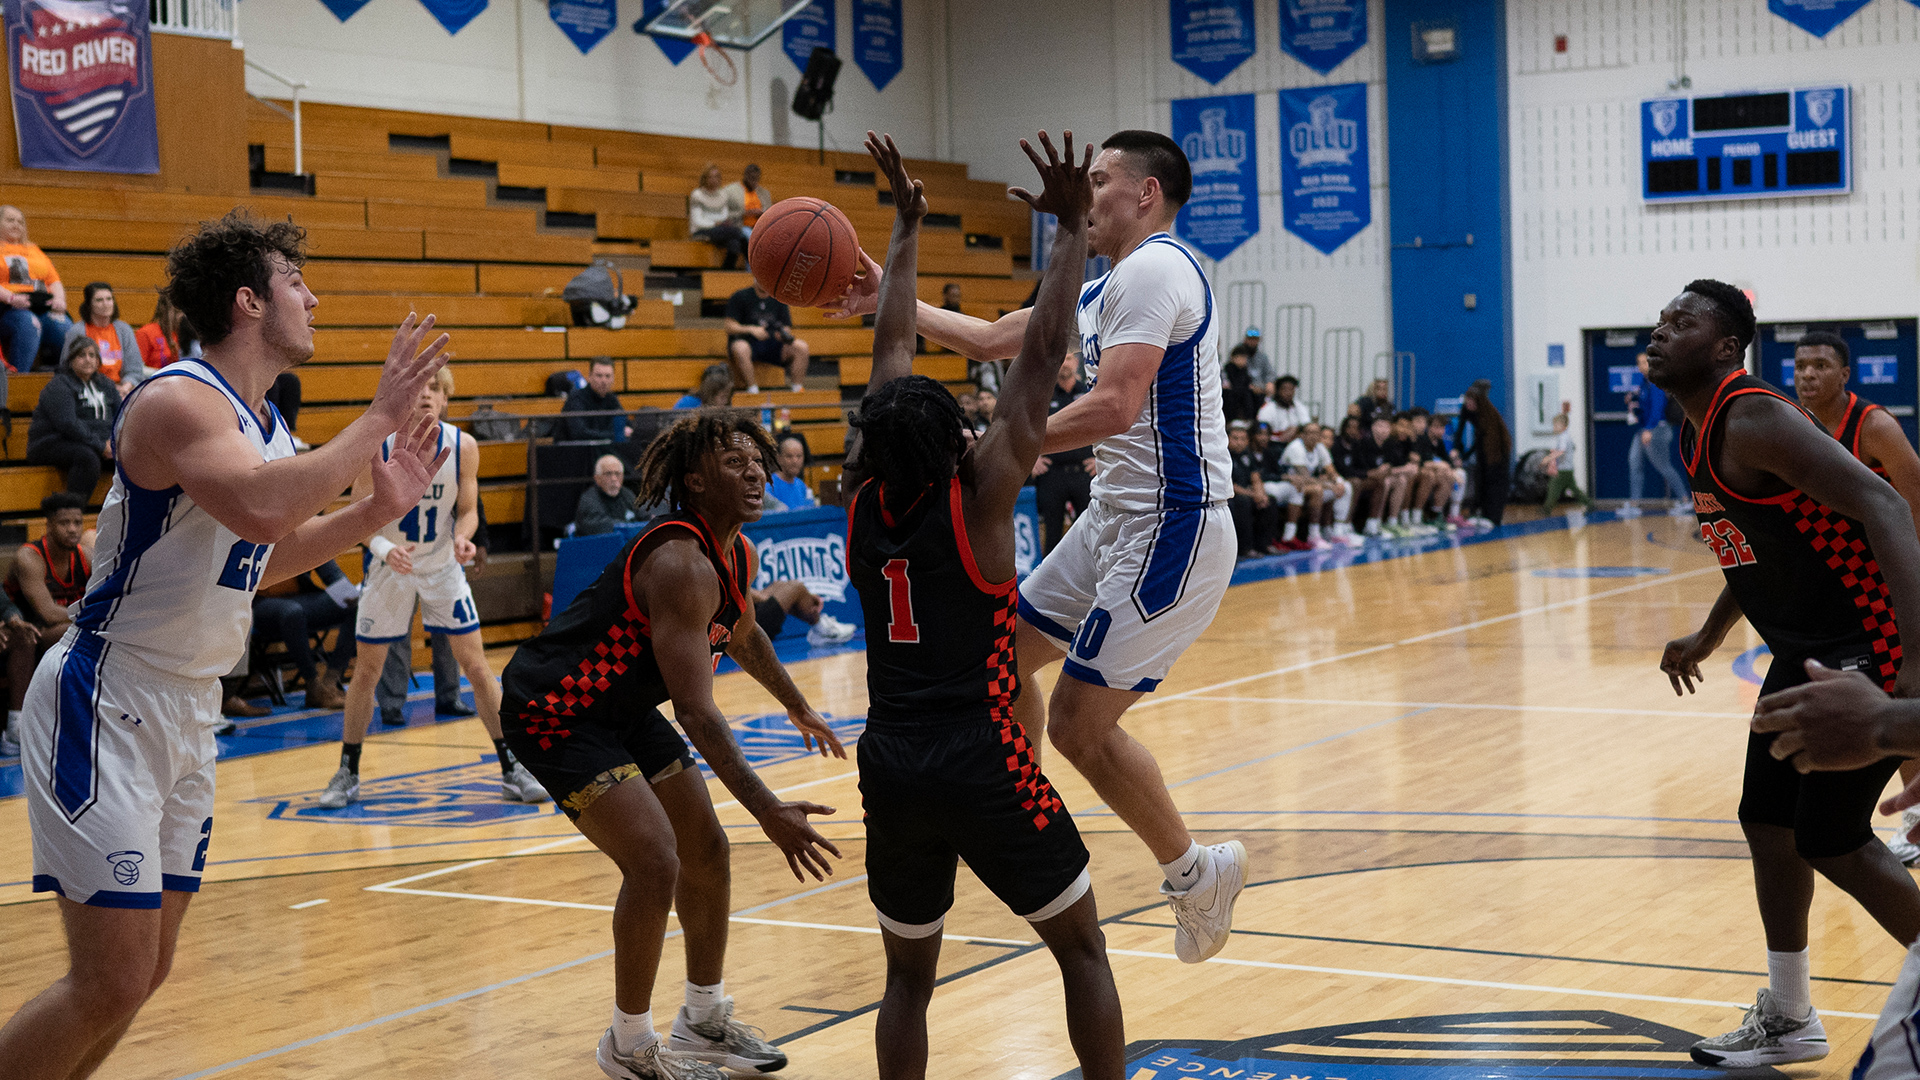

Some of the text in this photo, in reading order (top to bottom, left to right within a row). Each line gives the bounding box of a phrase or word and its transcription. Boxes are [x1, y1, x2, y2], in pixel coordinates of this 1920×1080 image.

[22, 42, 67, 76] RED
[72, 36, 136, 71] RIVER
[1185, 133, 1243, 162] OLLU
[1294, 124, 1353, 153] OLLU
[1651, 138, 1694, 157] HOME
[1786, 128, 1838, 149] GUEST
[398, 505, 438, 543] 41
[1700, 518, 1757, 569] 22
[760, 542, 844, 588] SAINTS
[452, 595, 476, 624] 41
[881, 559, 920, 643] 1
